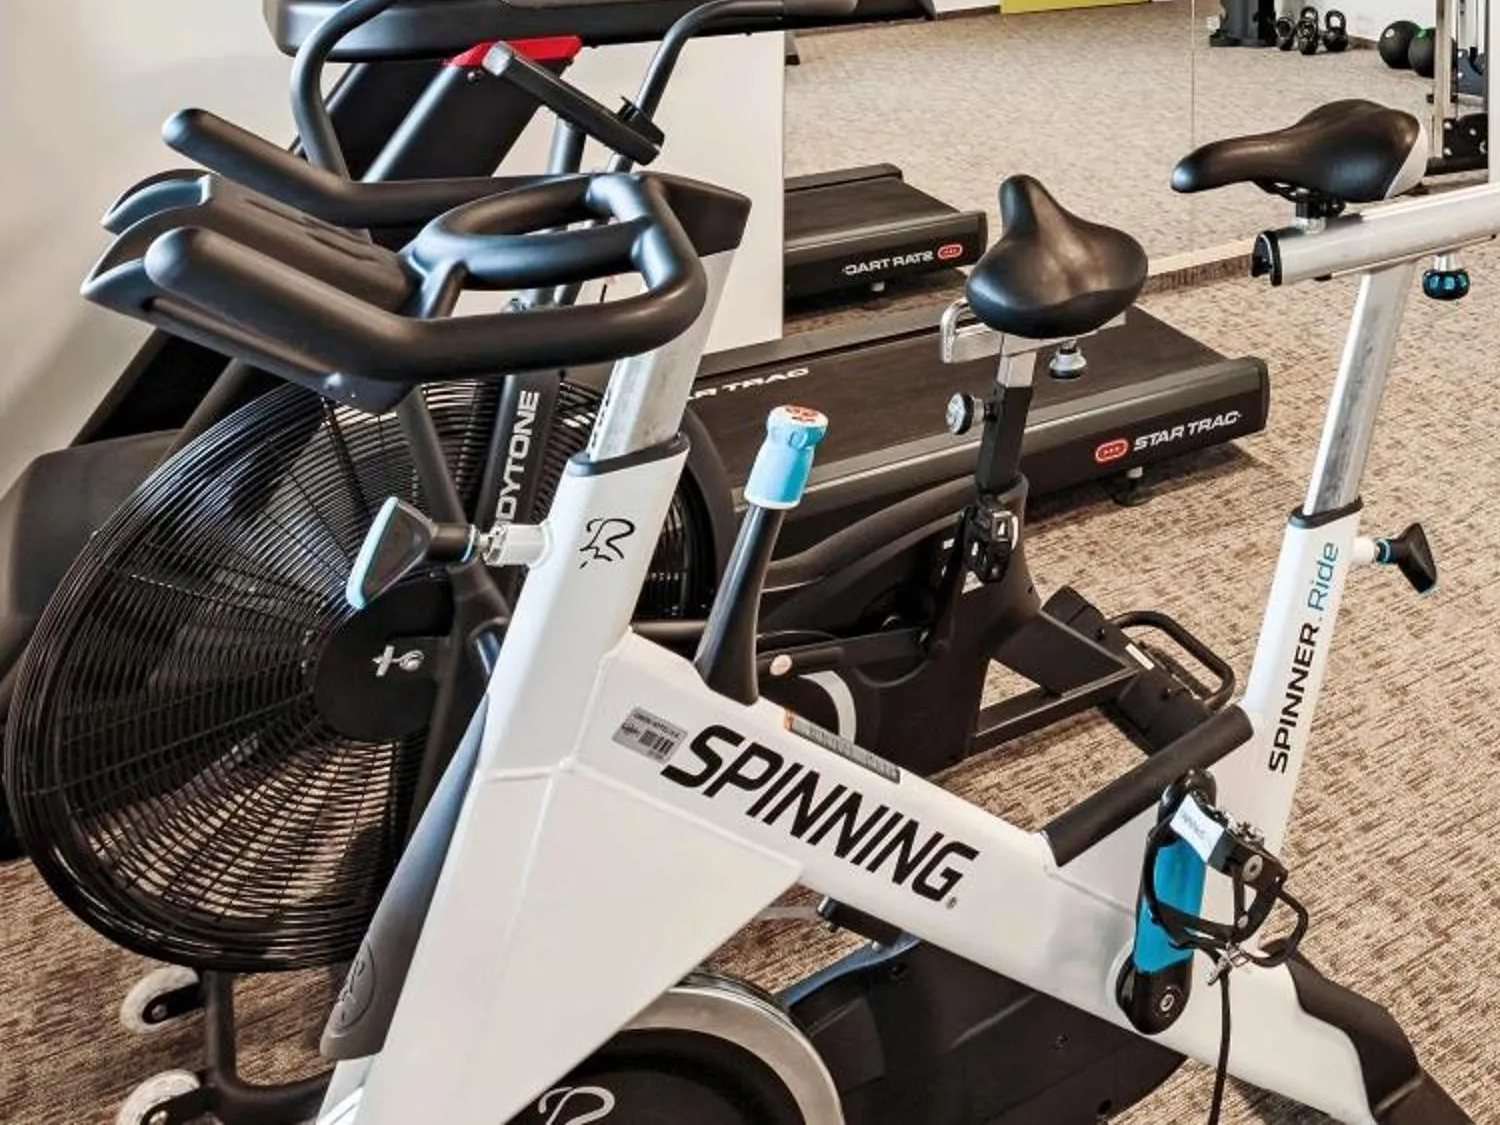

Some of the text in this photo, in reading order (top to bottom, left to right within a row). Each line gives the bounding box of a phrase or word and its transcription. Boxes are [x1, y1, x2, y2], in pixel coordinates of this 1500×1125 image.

[721, 368, 809, 392] TRAC
[1133, 410, 1242, 452] STAR TRAC
[495, 390, 541, 521] DYTONE
[1269, 542, 1339, 774] SPINNER Ride
[660, 725, 980, 901] SPINNING
